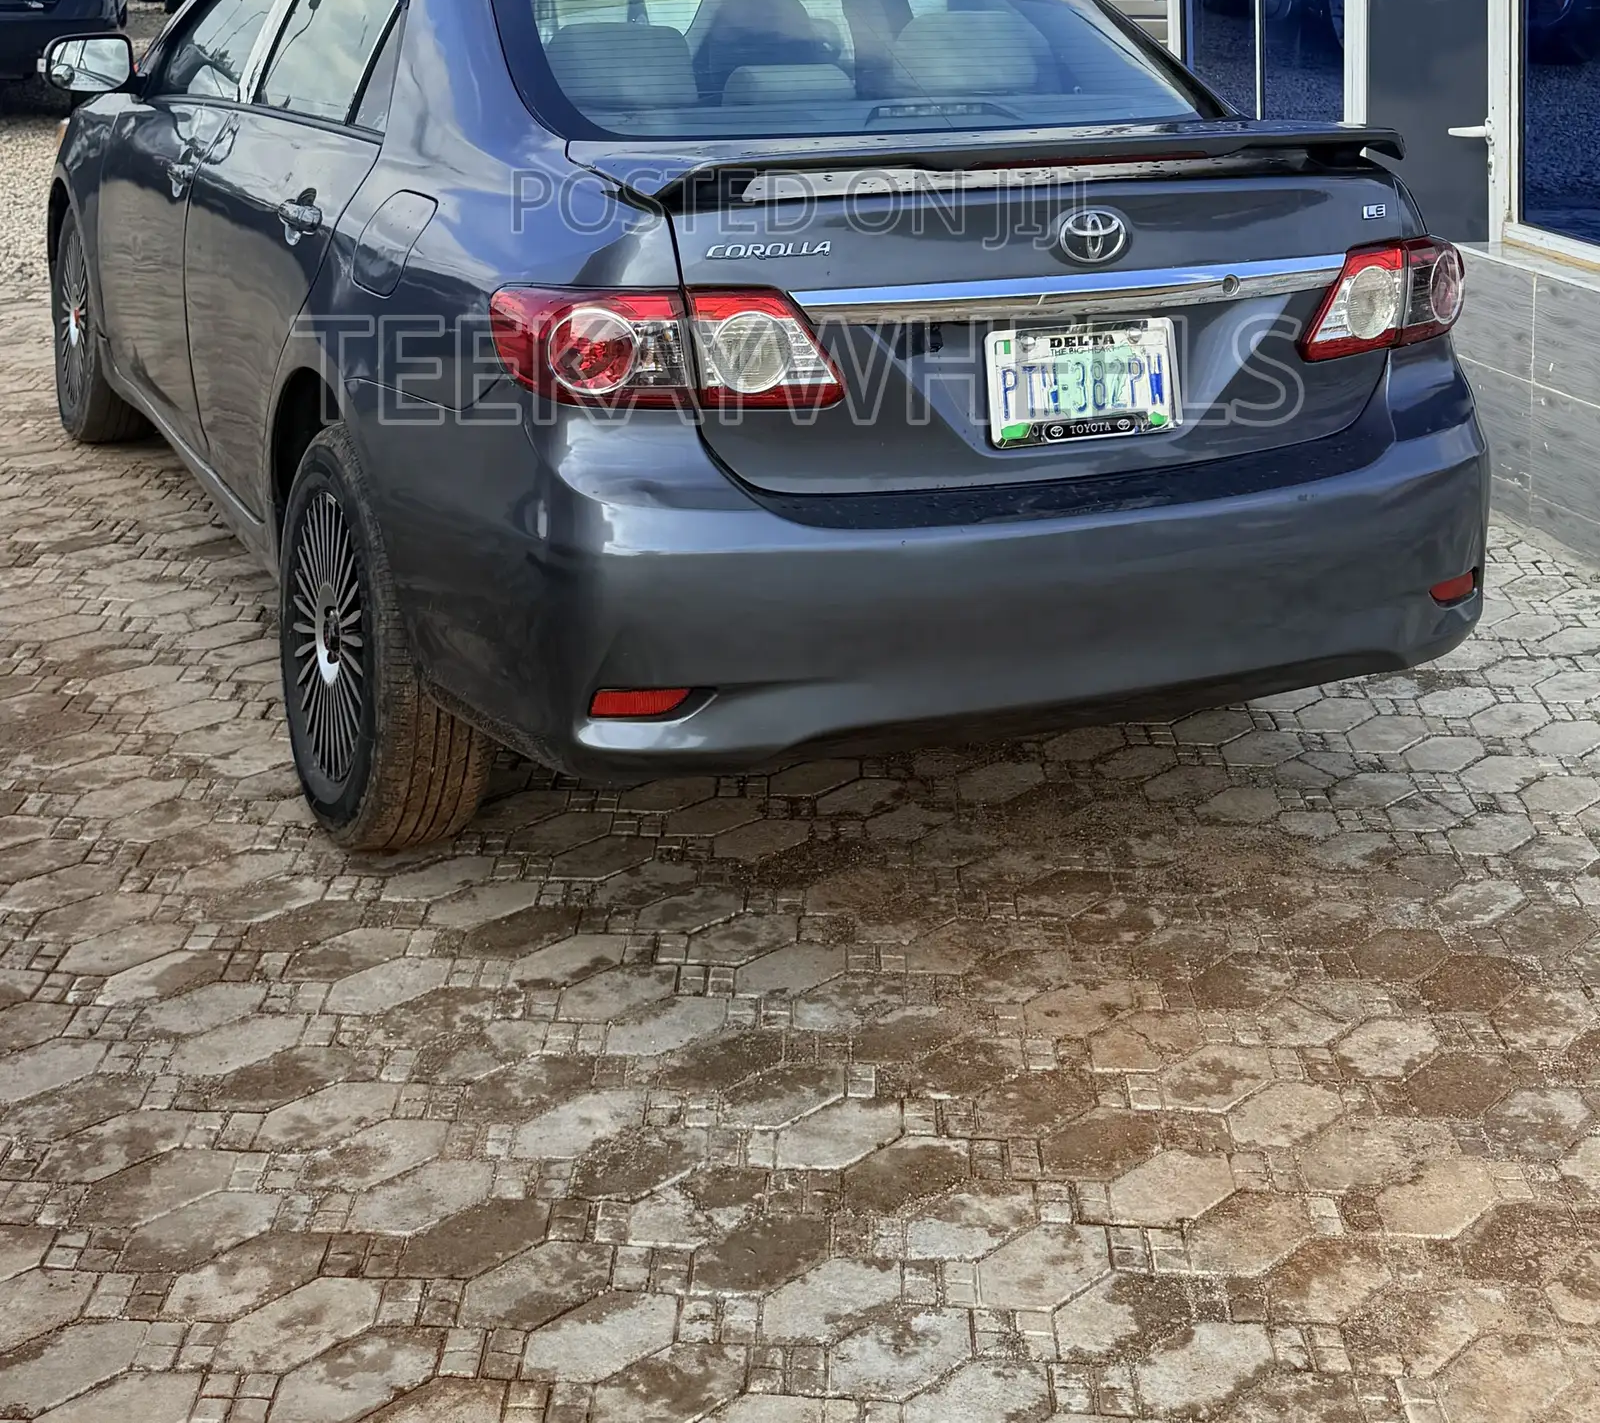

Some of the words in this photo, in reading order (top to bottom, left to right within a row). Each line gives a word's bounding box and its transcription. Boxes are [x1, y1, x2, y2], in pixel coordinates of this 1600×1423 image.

[1366, 205, 1384, 217] LE
[705, 240, 831, 260] COROLLA
[1049, 334, 1115, 348] DELTA
[1051, 348, 1066, 356] THE
[1068, 346, 1085, 355] BIG
[1087, 345, 1115, 354] HEART
[1070, 421, 1112, 435] TOYOTA
